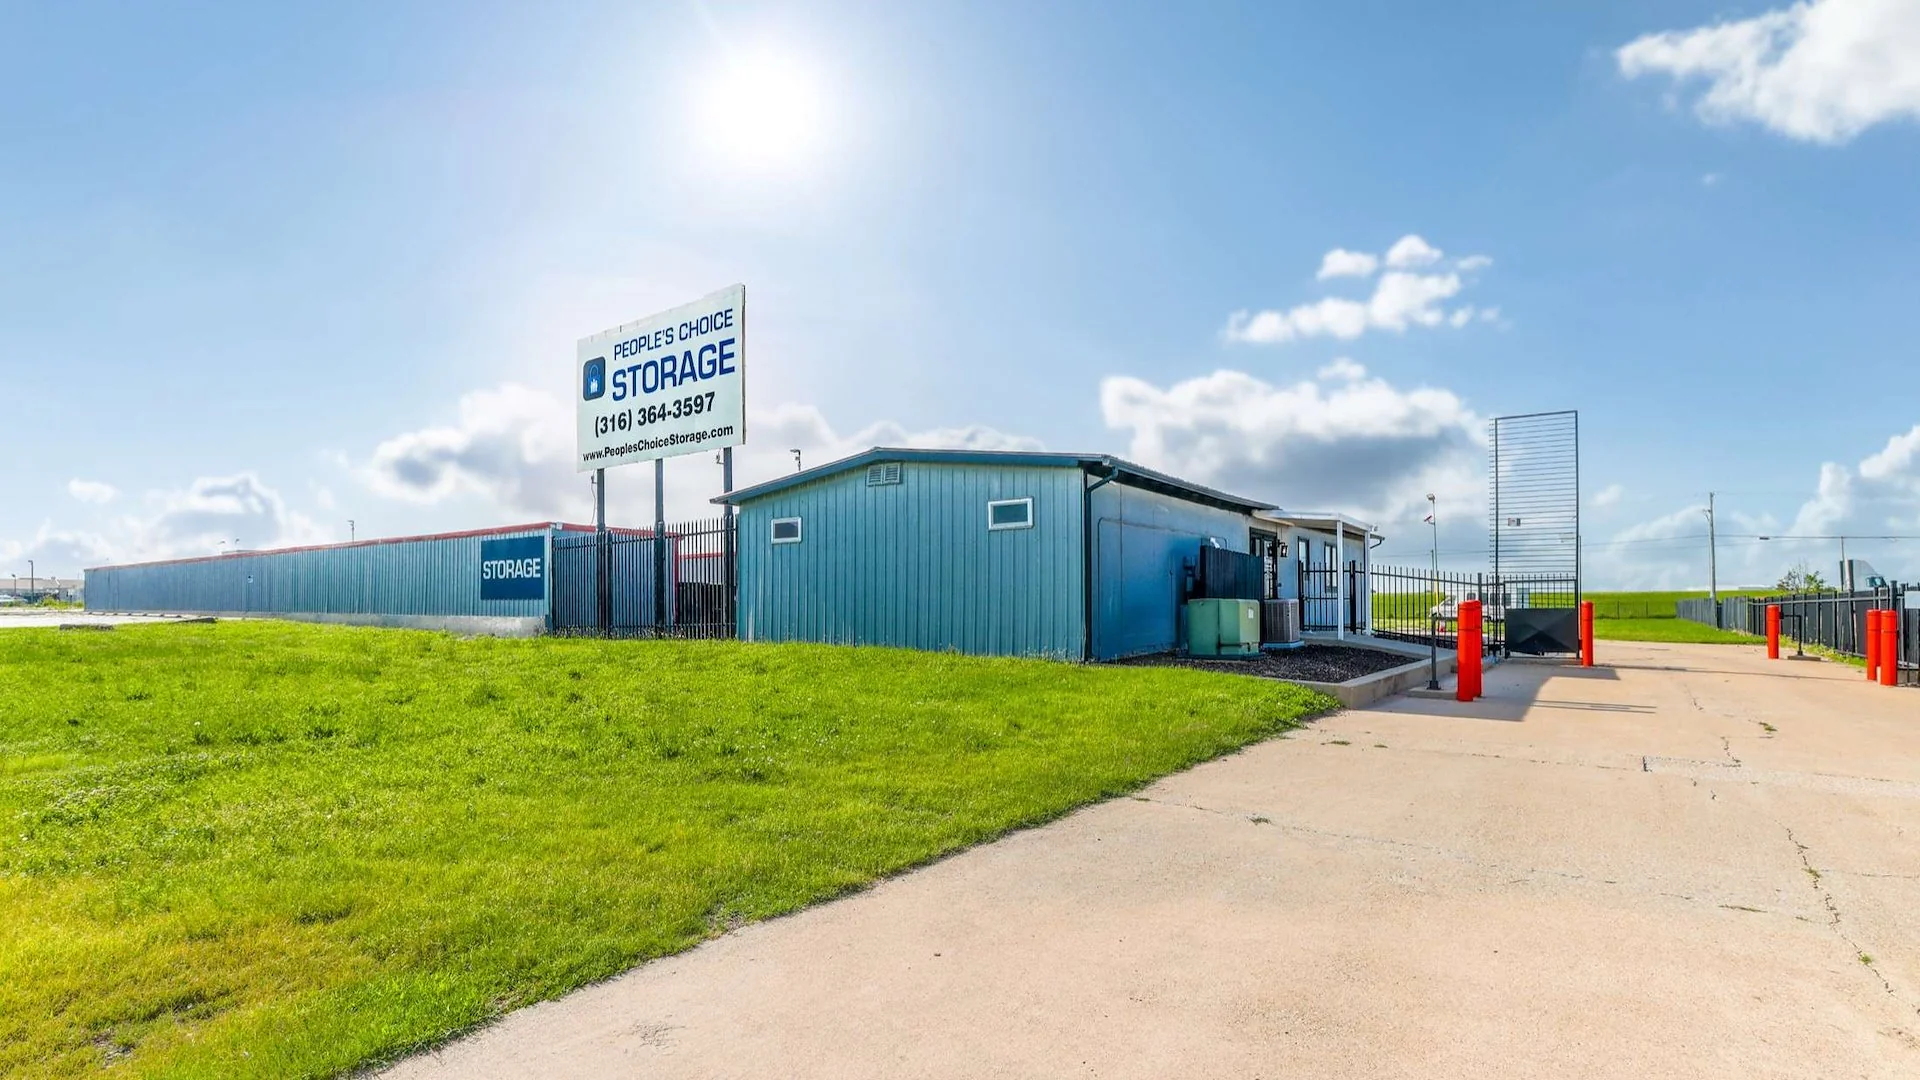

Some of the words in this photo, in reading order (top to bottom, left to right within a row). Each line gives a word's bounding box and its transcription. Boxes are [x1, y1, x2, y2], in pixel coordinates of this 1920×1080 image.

[614, 327, 674, 361] PEOPLE'S
[679, 308, 733, 341] CHOICE
[612, 337, 735, 402] STORAGE
[595, 409, 632, 438] (316)
[637, 391, 716, 427] 364-3597
[583, 425, 734, 462] www.PeoplesChoiceStorage.com
[482, 558, 541, 579] STORAGE
